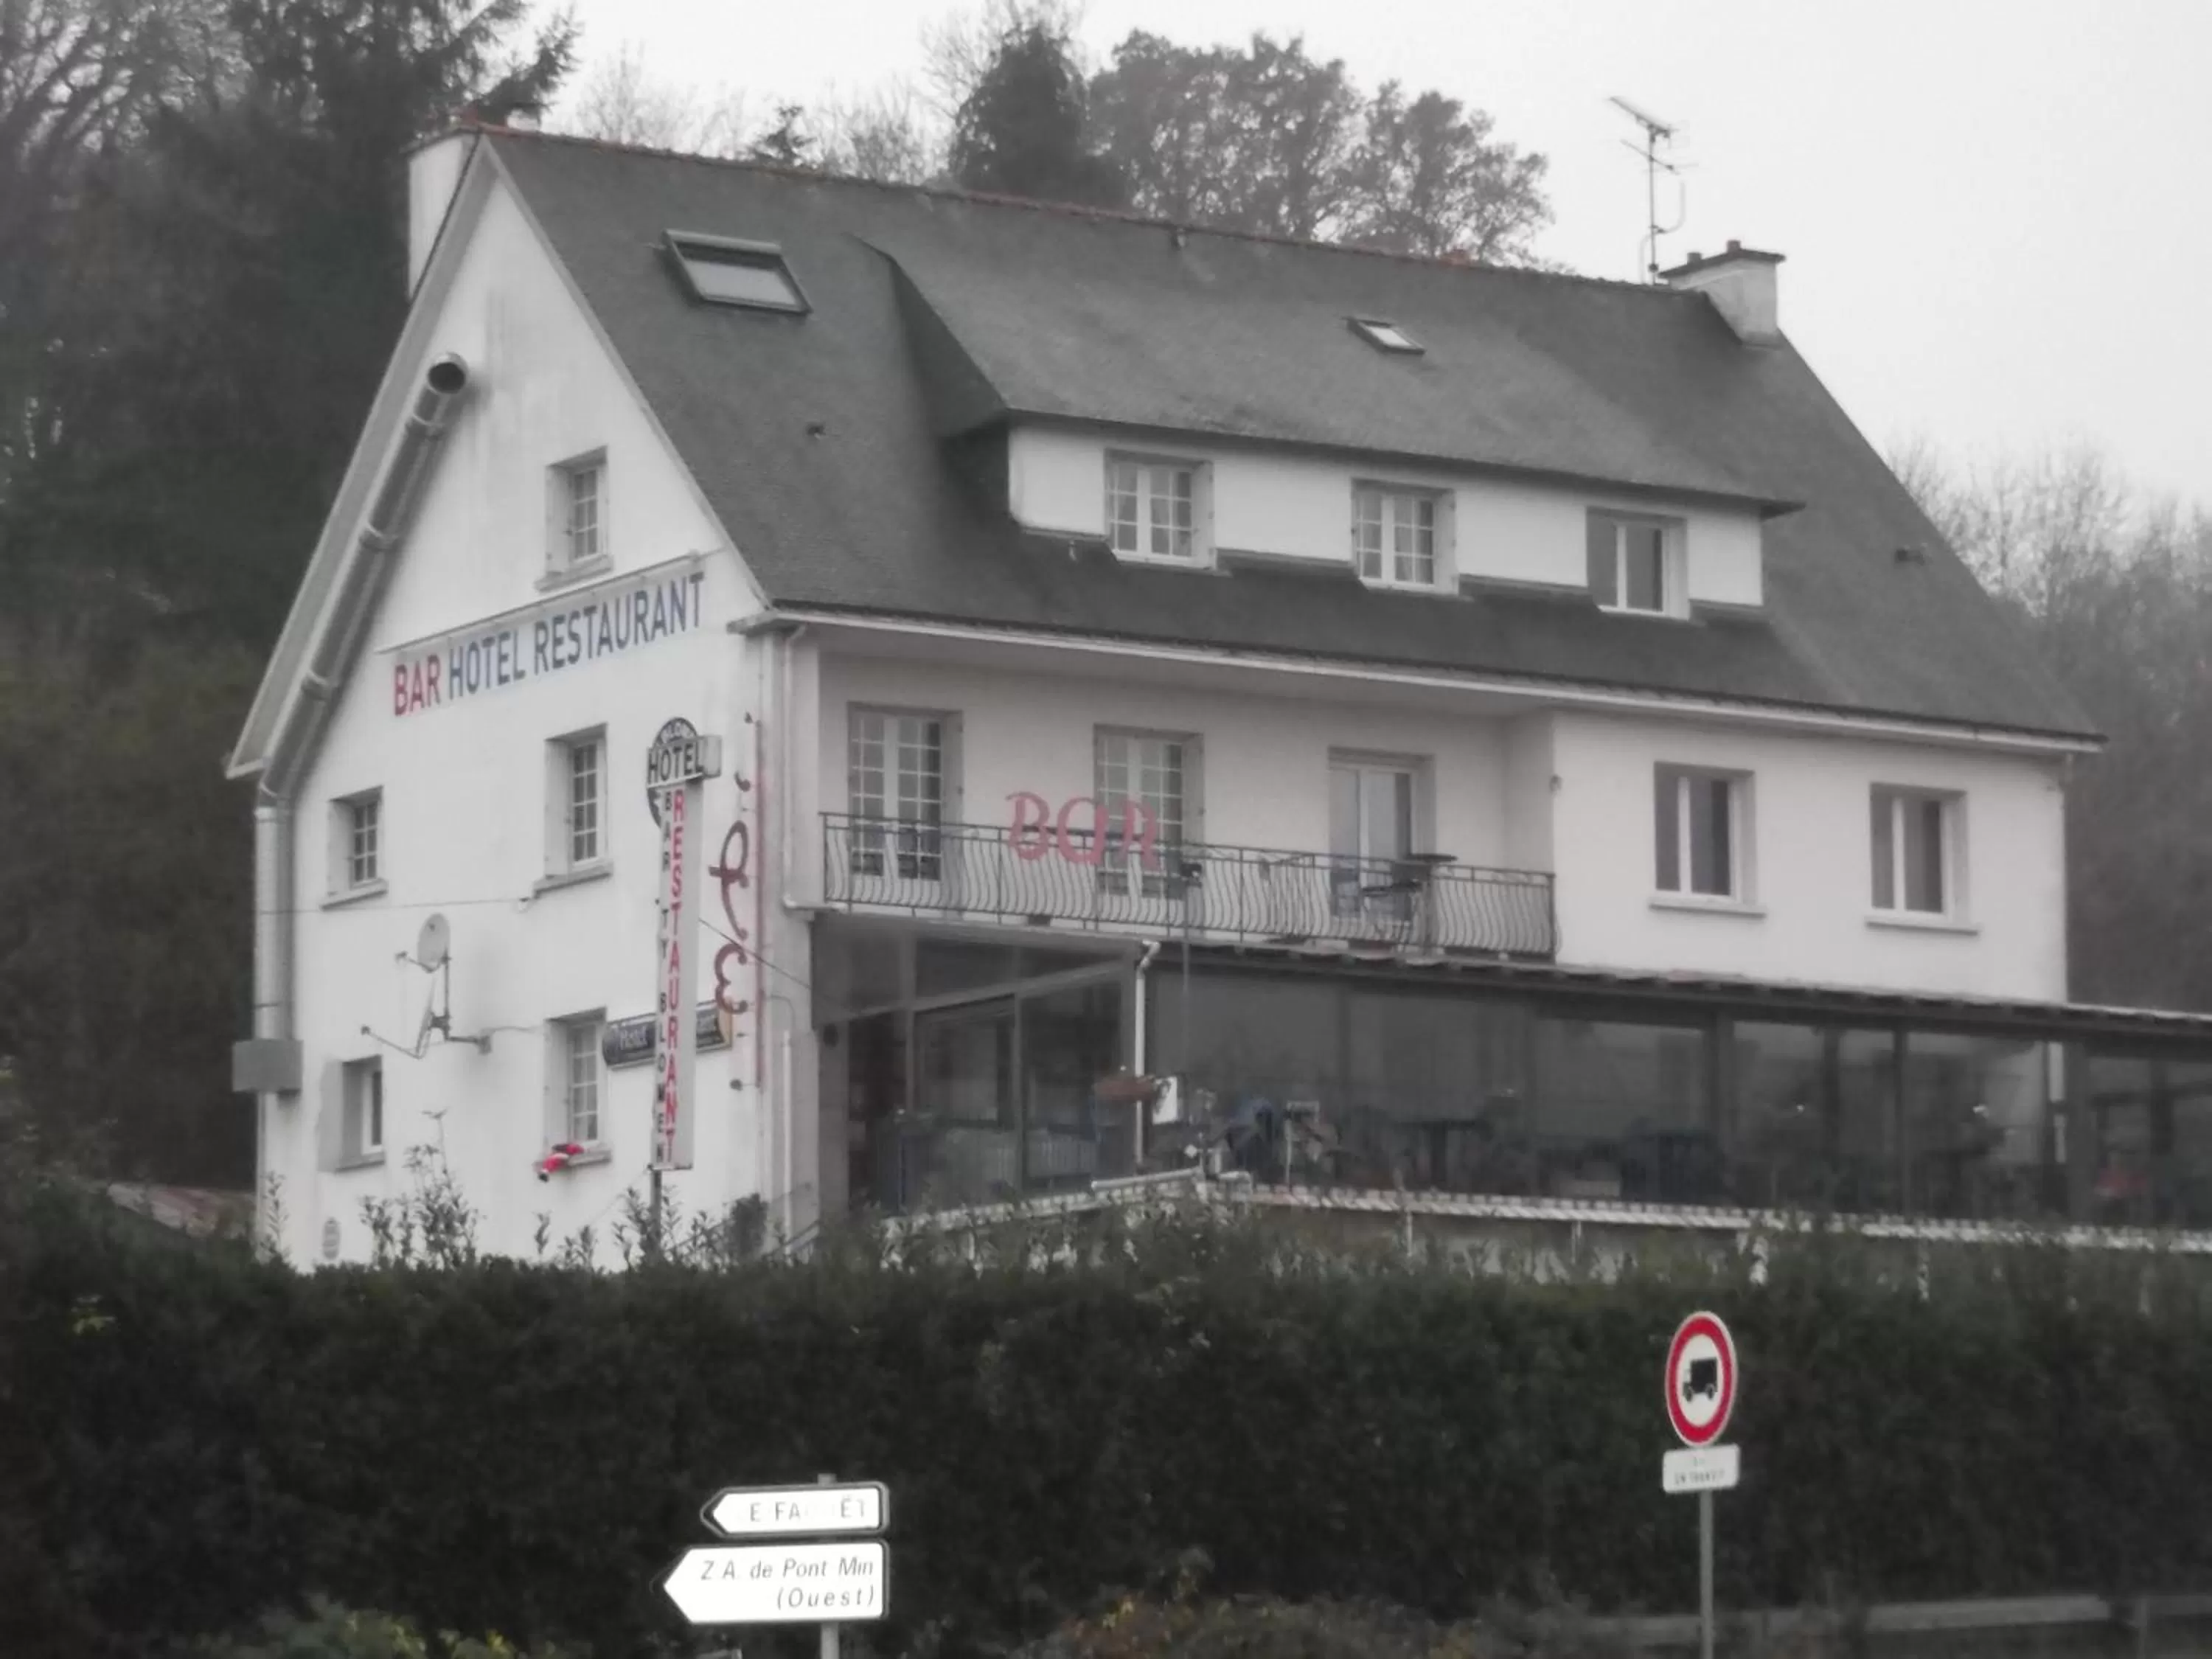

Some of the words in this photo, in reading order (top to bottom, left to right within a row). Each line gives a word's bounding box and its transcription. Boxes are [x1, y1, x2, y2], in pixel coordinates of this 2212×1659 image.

[394, 655, 441, 717] BAR
[448, 630, 526, 699] HOTEL
[534, 571, 704, 675] RESTAURANT
[647, 742, 704, 785] HOTEL
[665, 788, 685, 1163] RESTAURANT
[749, 1559, 773, 1580] de
[782, 1557, 828, 1579] Pont
[776, 1584, 874, 1611] (Ouest)
